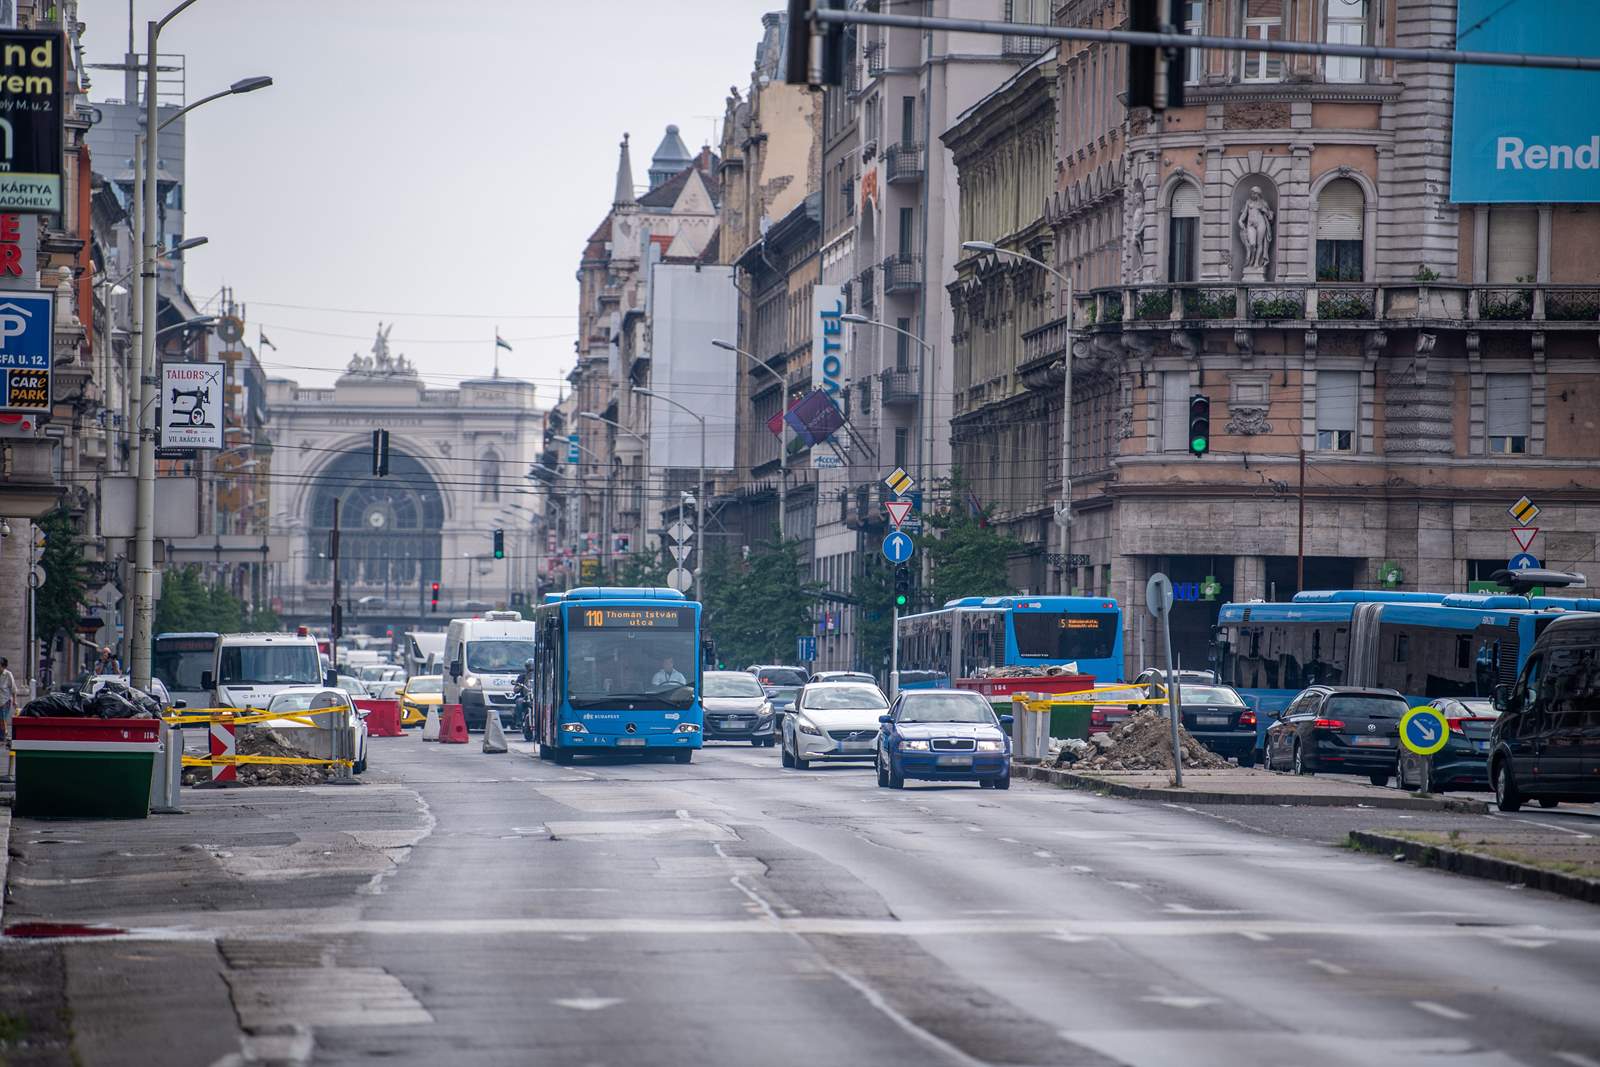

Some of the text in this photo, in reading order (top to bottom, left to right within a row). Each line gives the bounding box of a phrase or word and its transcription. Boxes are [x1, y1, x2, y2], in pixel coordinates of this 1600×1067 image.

[4, 40, 53, 67] nd
[1496, 135, 1600, 169] Rend
[1, 181, 52, 194] KÁRTYA
[18, 355, 29, 365] U.
[166, 370, 205, 380] TAILORS
[10, 389, 46, 401] PARK
[586, 610, 603, 627] 110
[645, 609, 677, 618] István
